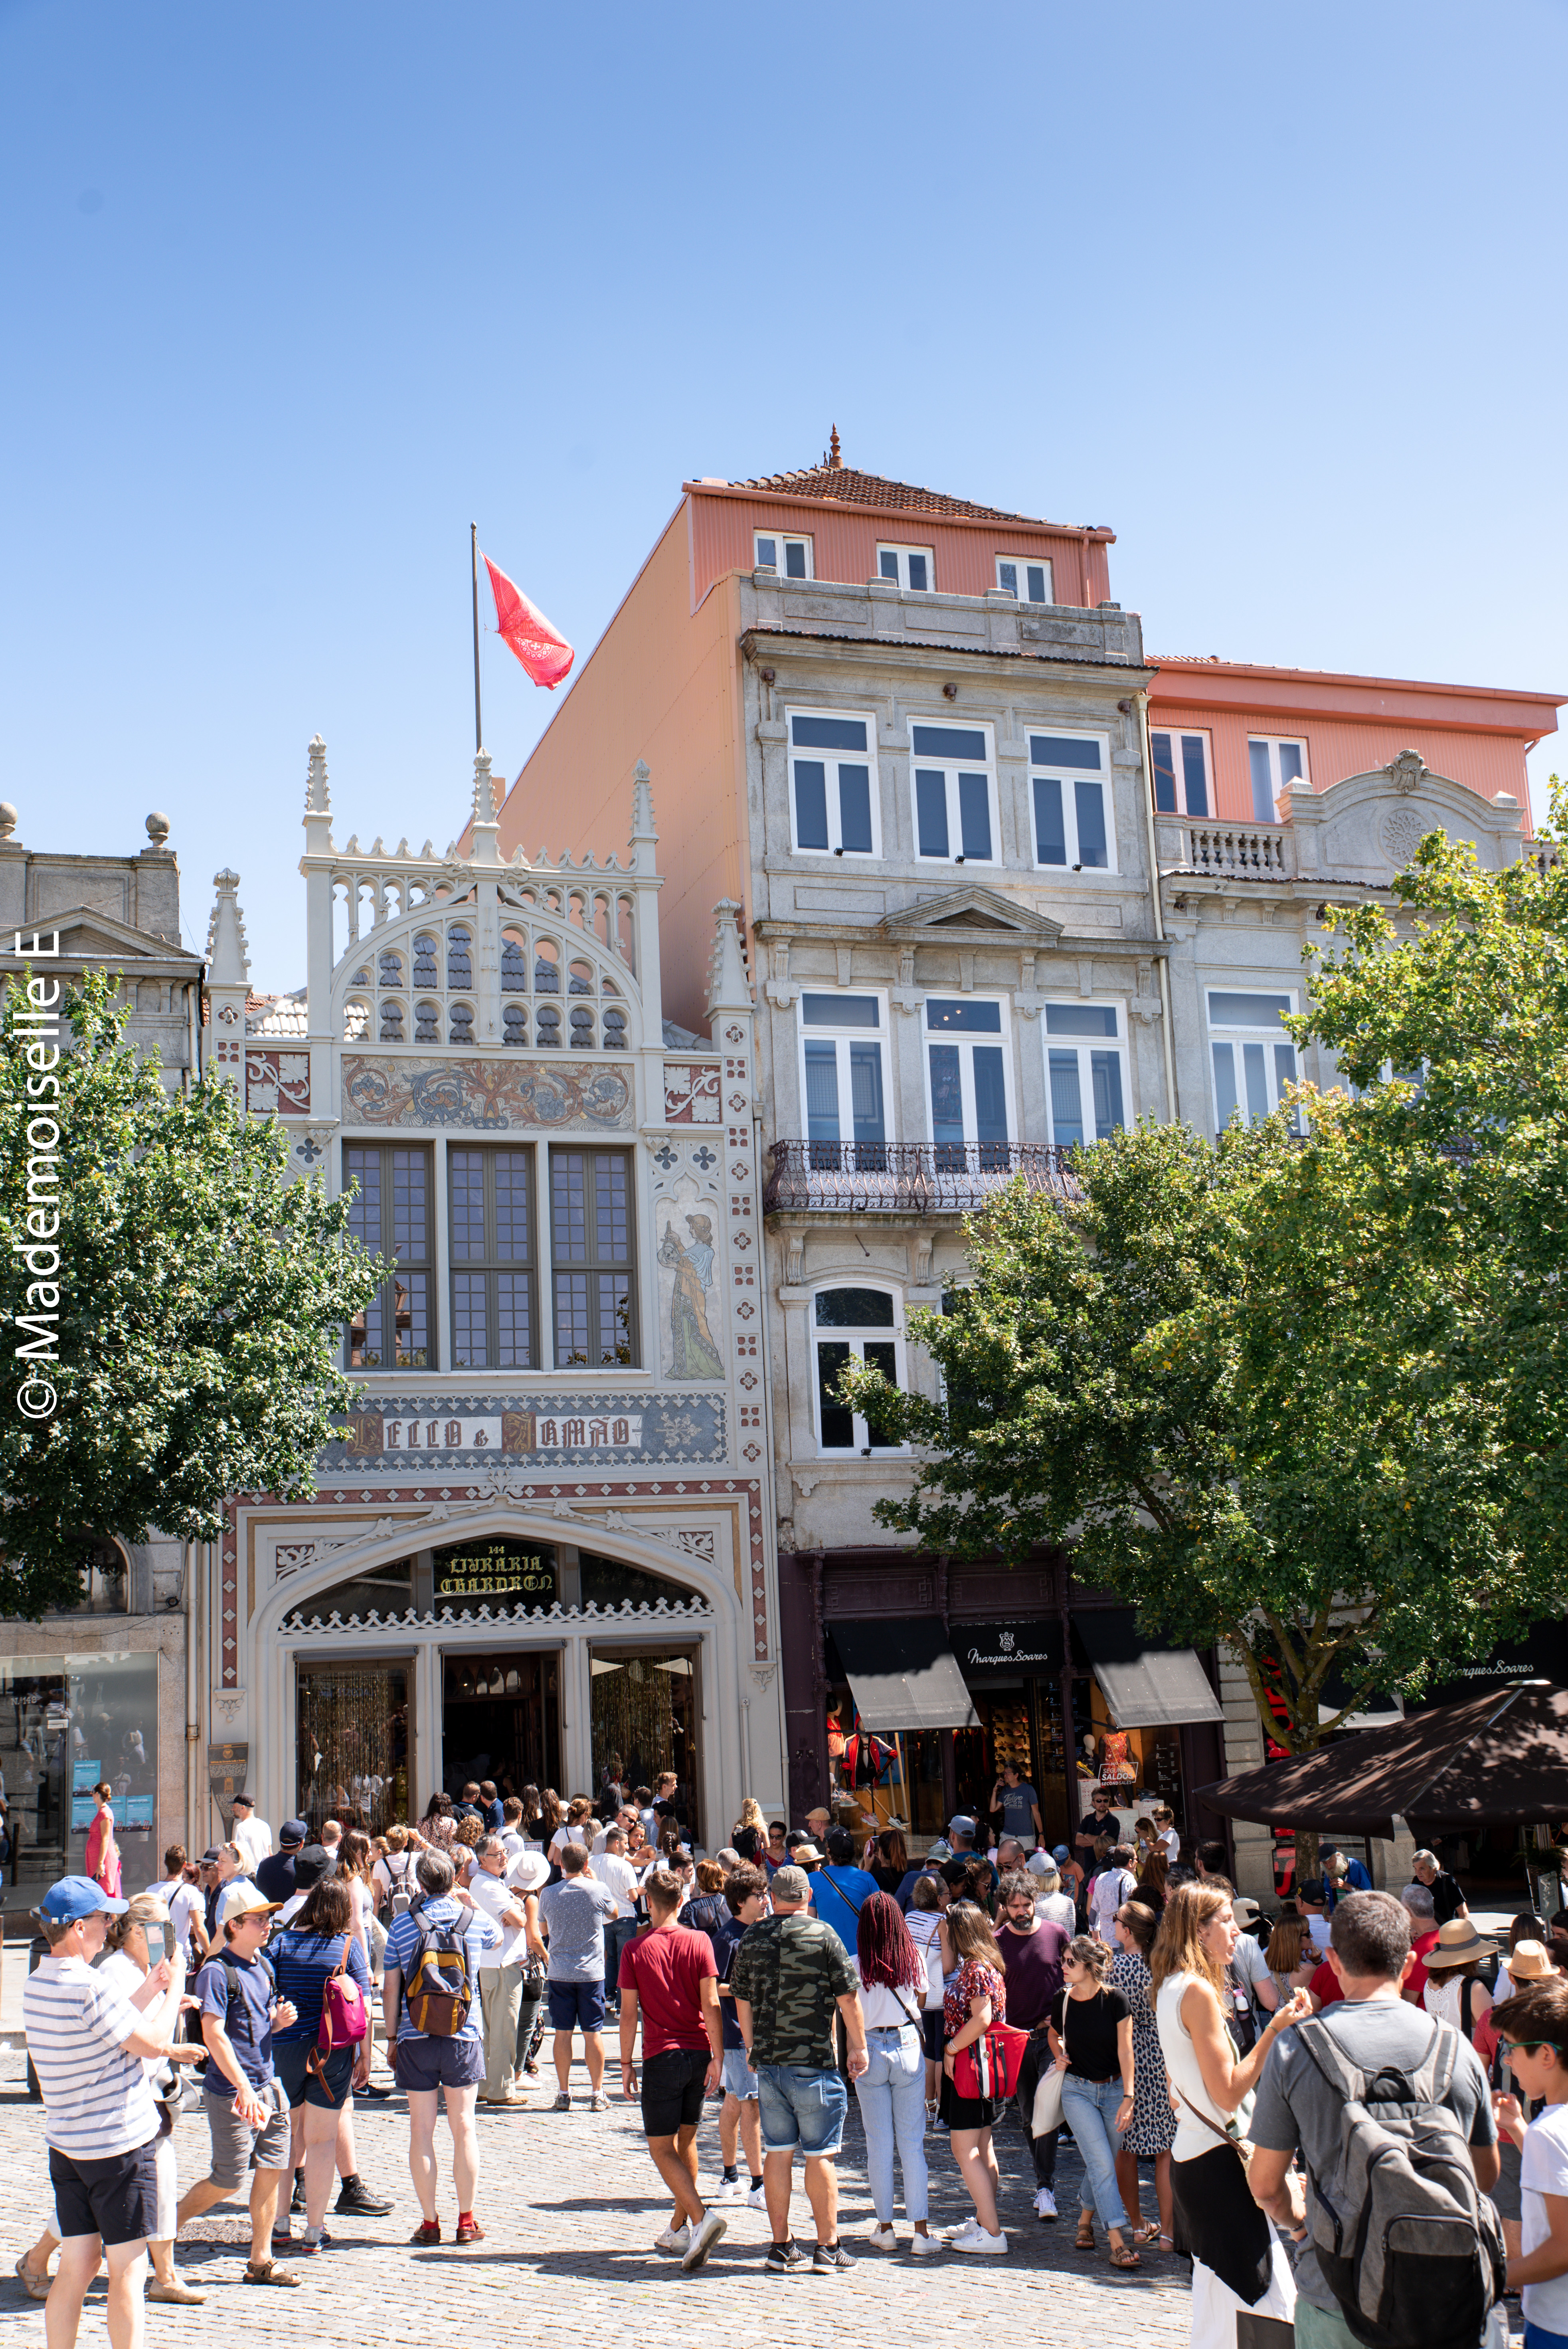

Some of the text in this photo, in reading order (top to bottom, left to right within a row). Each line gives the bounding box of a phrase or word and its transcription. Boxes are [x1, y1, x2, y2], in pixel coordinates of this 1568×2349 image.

[474, 1429, 489, 1447] &
[488, 1546, 505, 1554] 144
[968, 1648, 1048, 1665] Marques Soares
[1492, 1659, 1534, 1674] Soares
[1101, 1773, 1133, 1781] SALDOS
